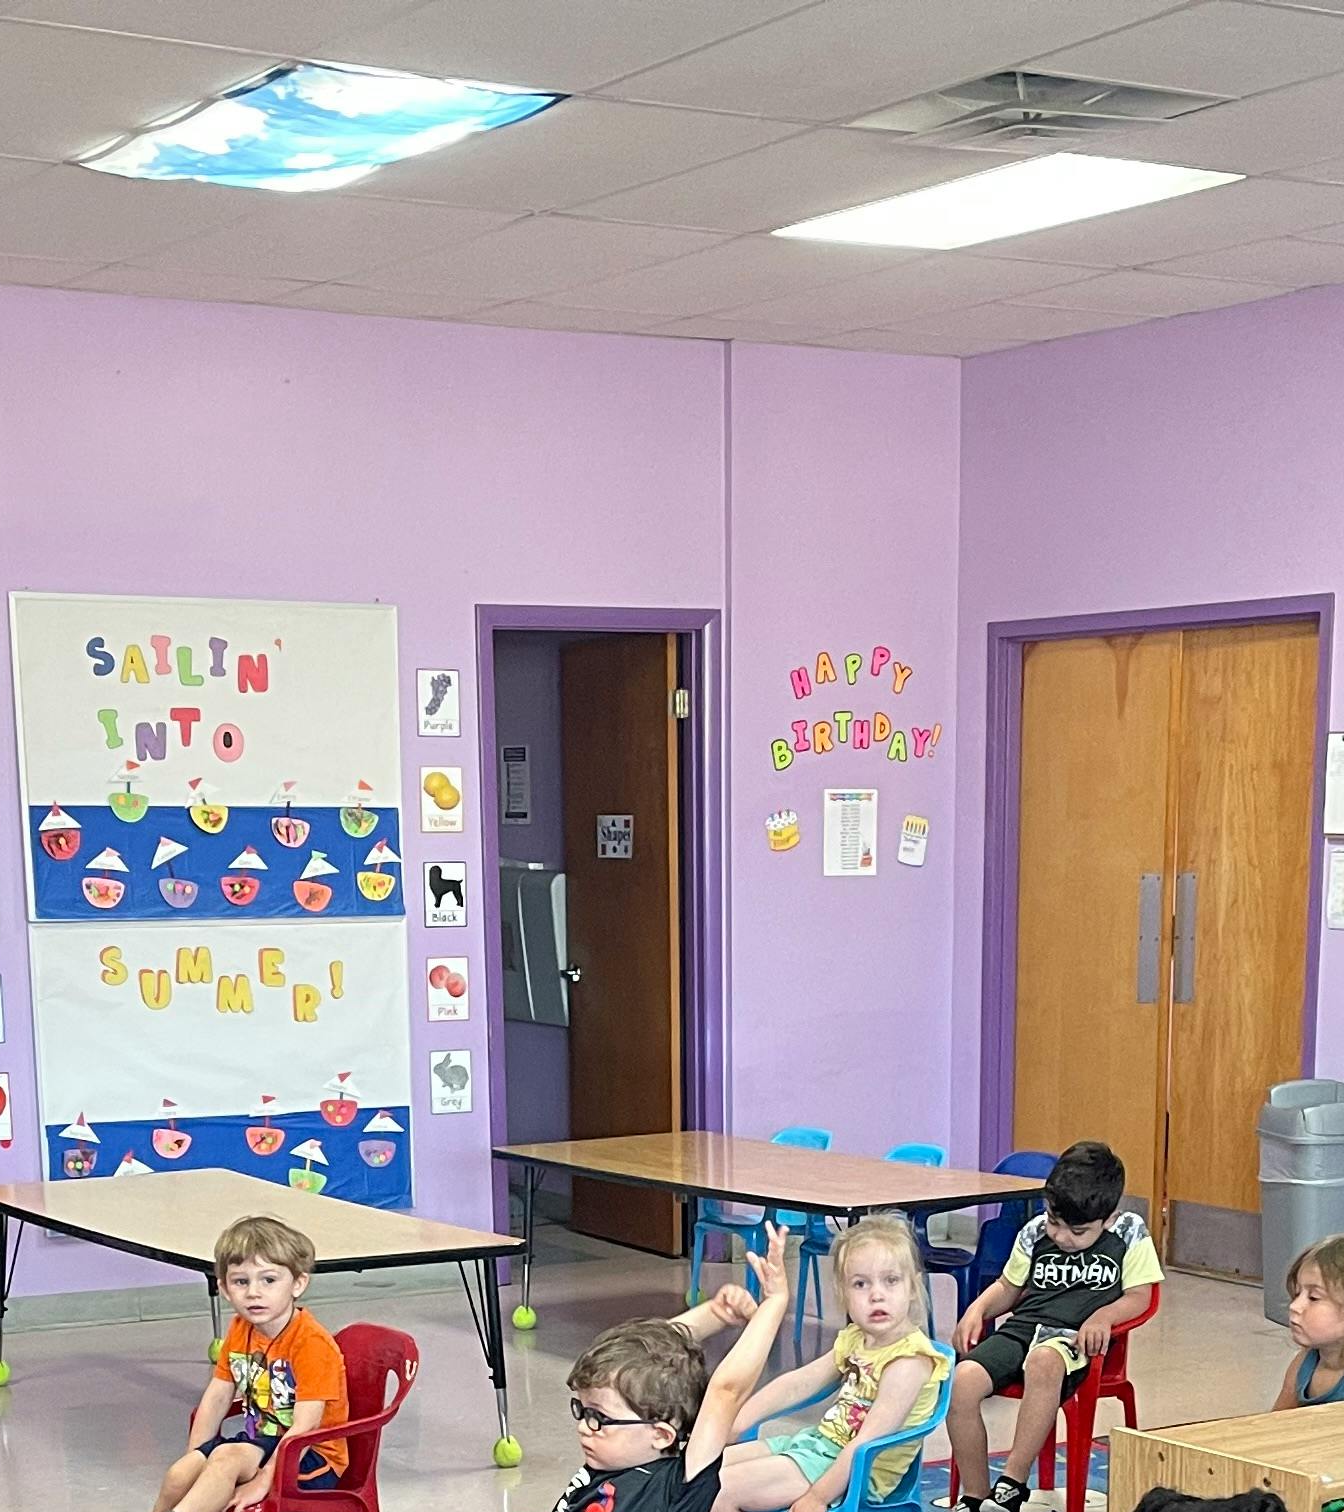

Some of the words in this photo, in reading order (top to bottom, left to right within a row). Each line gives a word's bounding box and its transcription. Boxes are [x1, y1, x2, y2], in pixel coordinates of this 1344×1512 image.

[86, 635, 282, 693] SAILIN'
[790, 646, 913, 699] HAPPY
[97, 708, 245, 762] INTO
[424, 720, 454, 733] Purple
[771, 711, 943, 771] BIRTHDAY!
[601, 825, 632, 845] Shapes
[432, 913, 458, 922] Black
[99, 946, 345, 1022] SUMMER!
[438, 1006, 458, 1017] Pink
[441, 1098, 462, 1109] Grey
[1033, 1262, 1117, 1283] BATMAN
